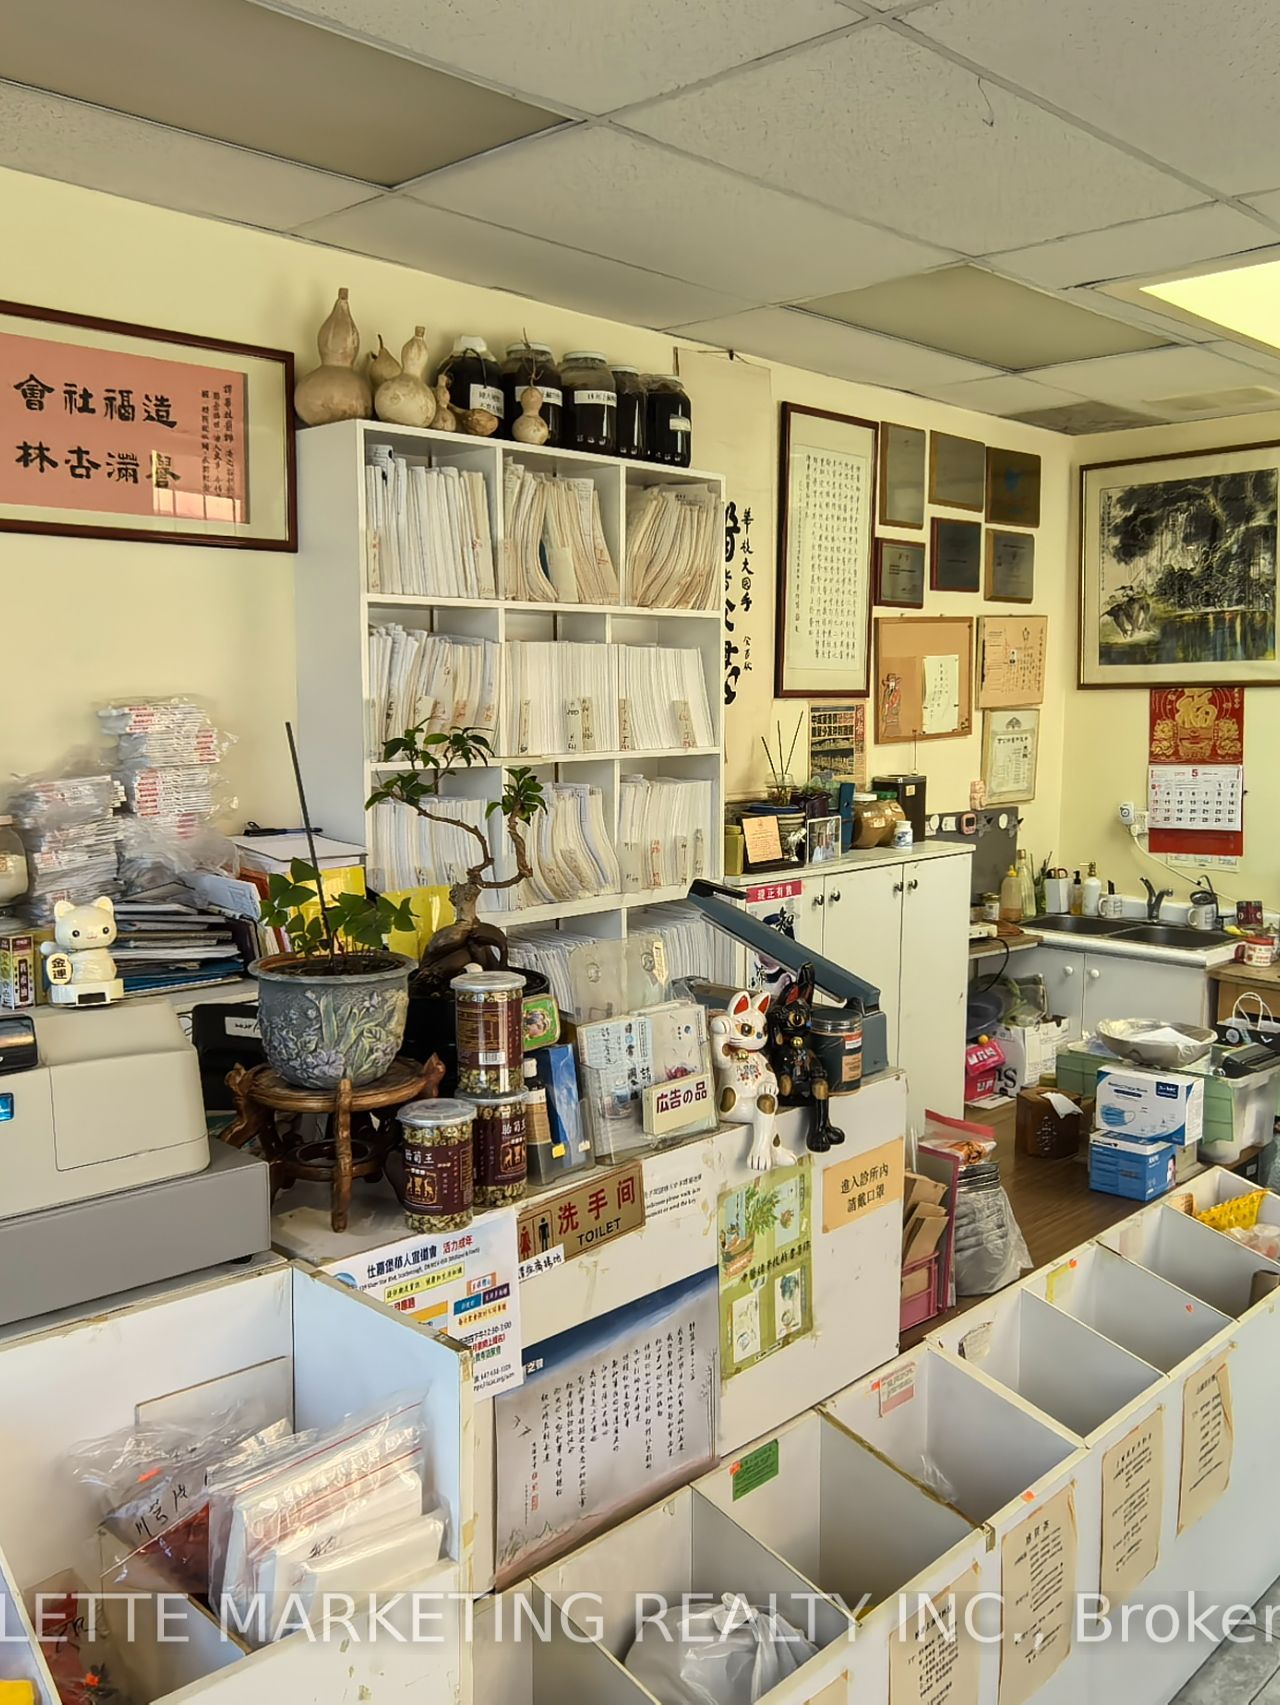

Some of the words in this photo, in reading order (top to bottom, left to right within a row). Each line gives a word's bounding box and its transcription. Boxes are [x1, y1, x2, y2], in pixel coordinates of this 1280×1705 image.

[1192, 769, 1198, 777] 5
[657, 1081, 707, 1114] 広告の品
[841, 1162, 889, 1194] 進入診所內
[558, 1176, 636, 1235] 洗手间
[577, 1218, 622, 1247] TOILET
